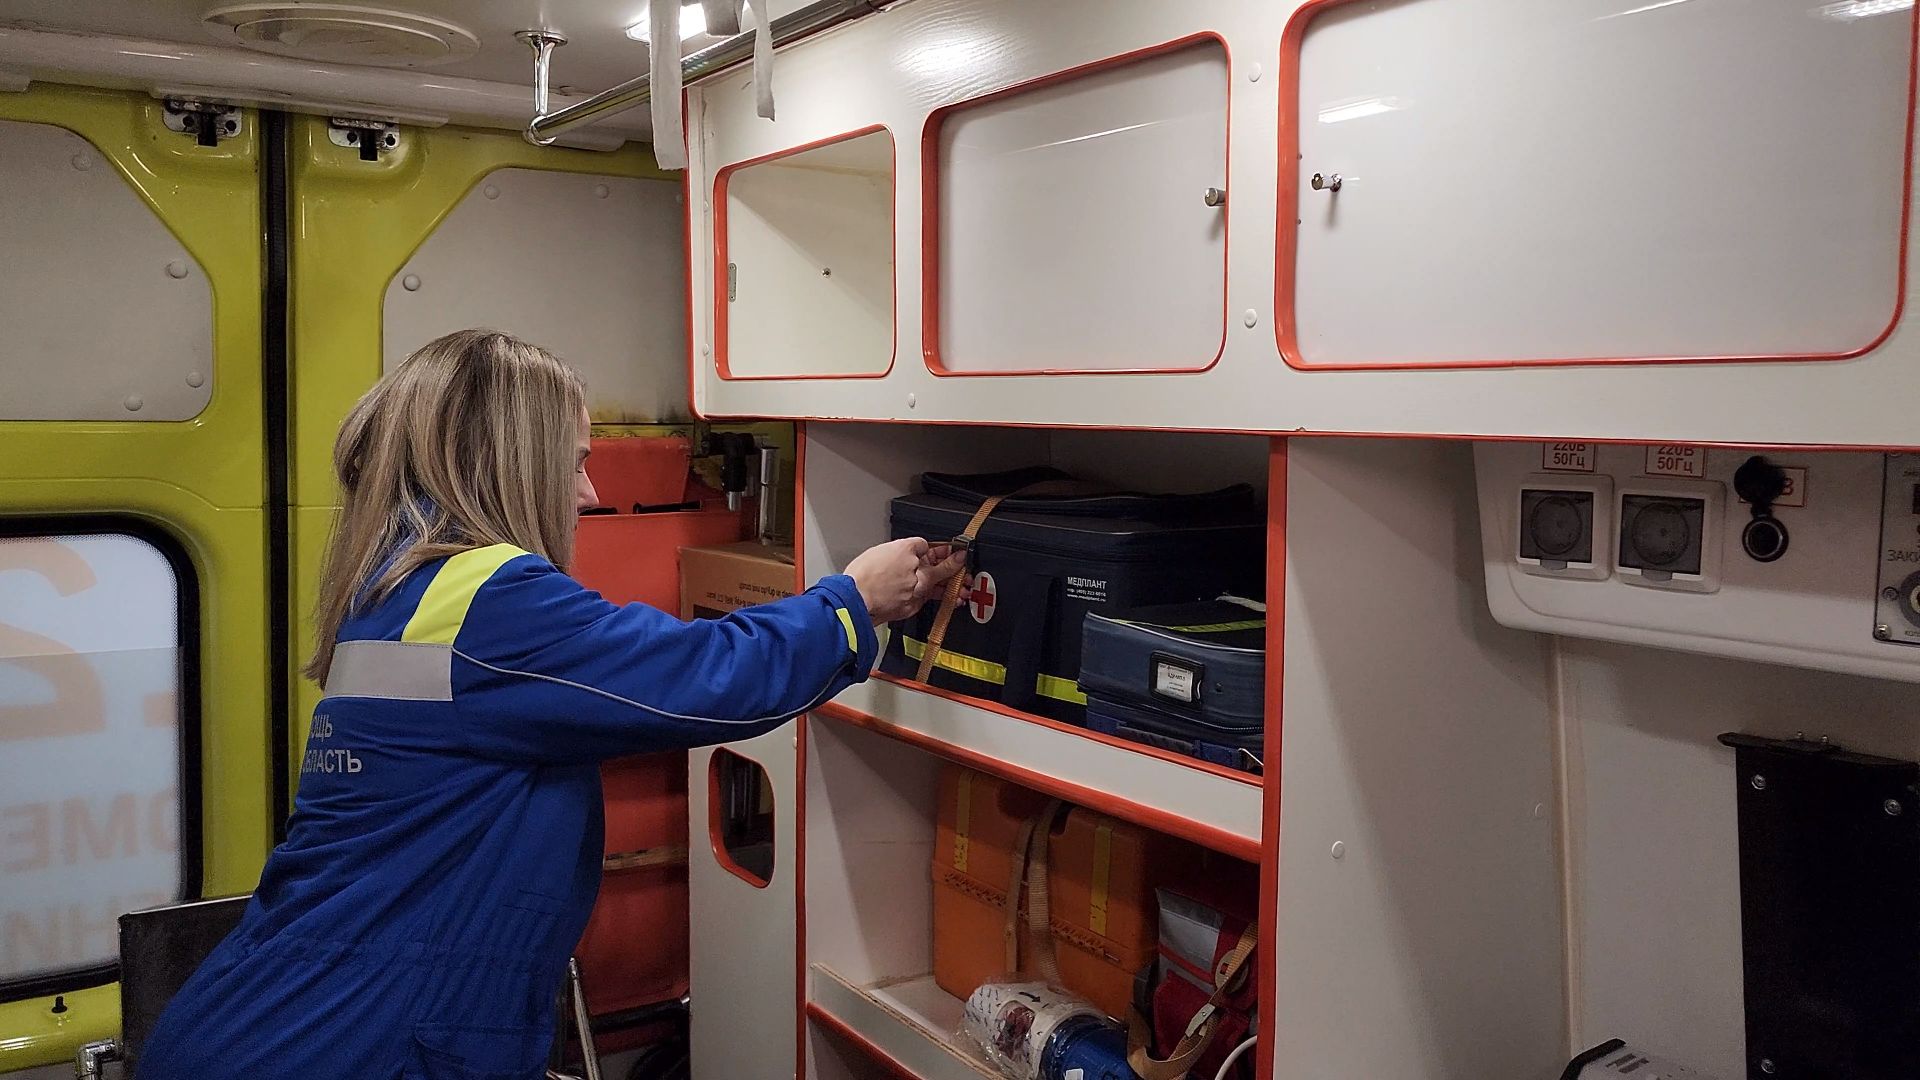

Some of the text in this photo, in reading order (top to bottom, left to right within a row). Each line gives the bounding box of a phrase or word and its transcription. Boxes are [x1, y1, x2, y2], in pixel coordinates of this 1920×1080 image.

[1552, 452, 1585, 468] 50Гц
[1657, 456, 1693, 473] 50Гц
[1067, 576, 1107, 590] МЕДПЛАНТ
